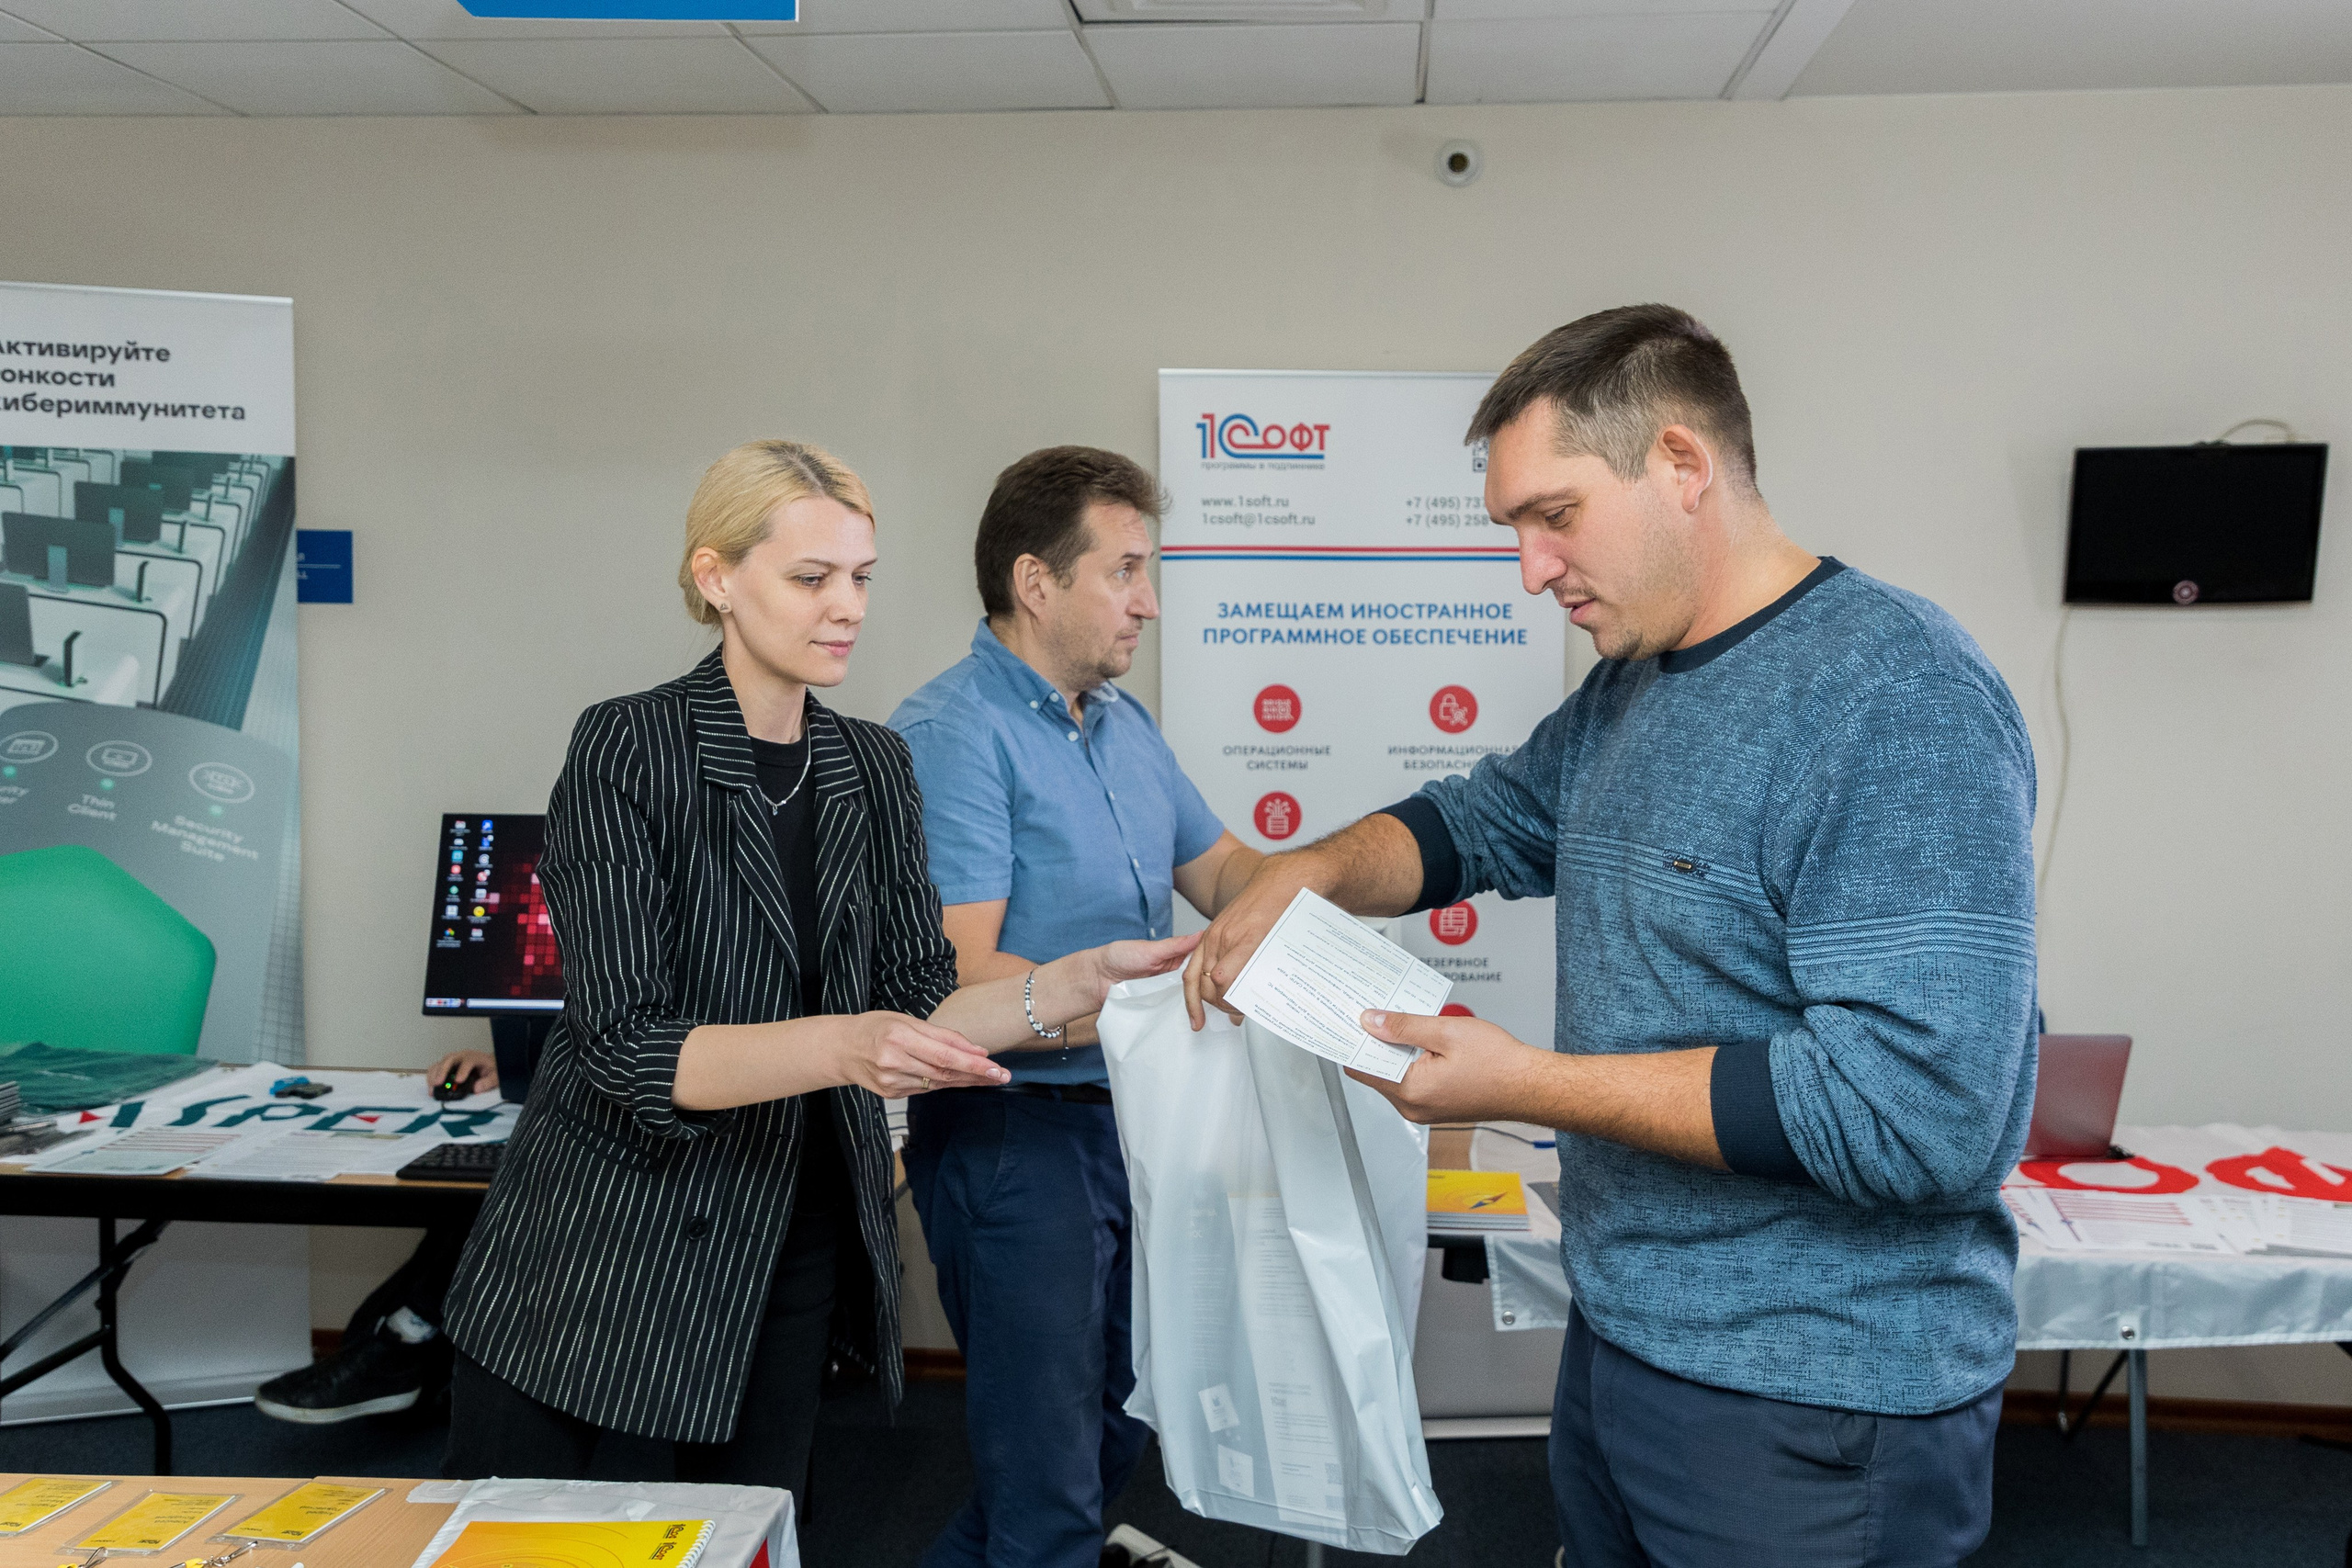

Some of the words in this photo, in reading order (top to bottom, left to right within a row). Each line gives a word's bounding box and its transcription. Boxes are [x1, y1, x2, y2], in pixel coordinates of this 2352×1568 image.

[0, 368, 115, 387] онкости
[0, 392, 245, 422] ибериммунитета
[1425, 496, 1461, 510] (495)
[1464, 496, 1486, 508] 73
[1203, 512, 1316, 526] 1csoft@1csoft.ru
[1425, 514, 1461, 528] (495)
[1464, 514, 1489, 526] 258
[1217, 603, 1344, 622] ЗАМЕЩАЕМ
[1351, 603, 1513, 620] ИНОСТРАННОЕ
[1204, 628, 1365, 645] ПРОГРАММНОЕ
[1372, 628, 1528, 646] ОБЕСПЕЧЕНИЕ
[1223, 745, 1330, 756] ОПЕРАЦИОННЫЕ
[1247, 760, 1308, 771] СИСТЕМЫ
[67, 803, 118, 821] Client
[174, 815, 244, 844] Security
[151, 820, 258, 862] Management
[181, 840, 225, 863] Suite
